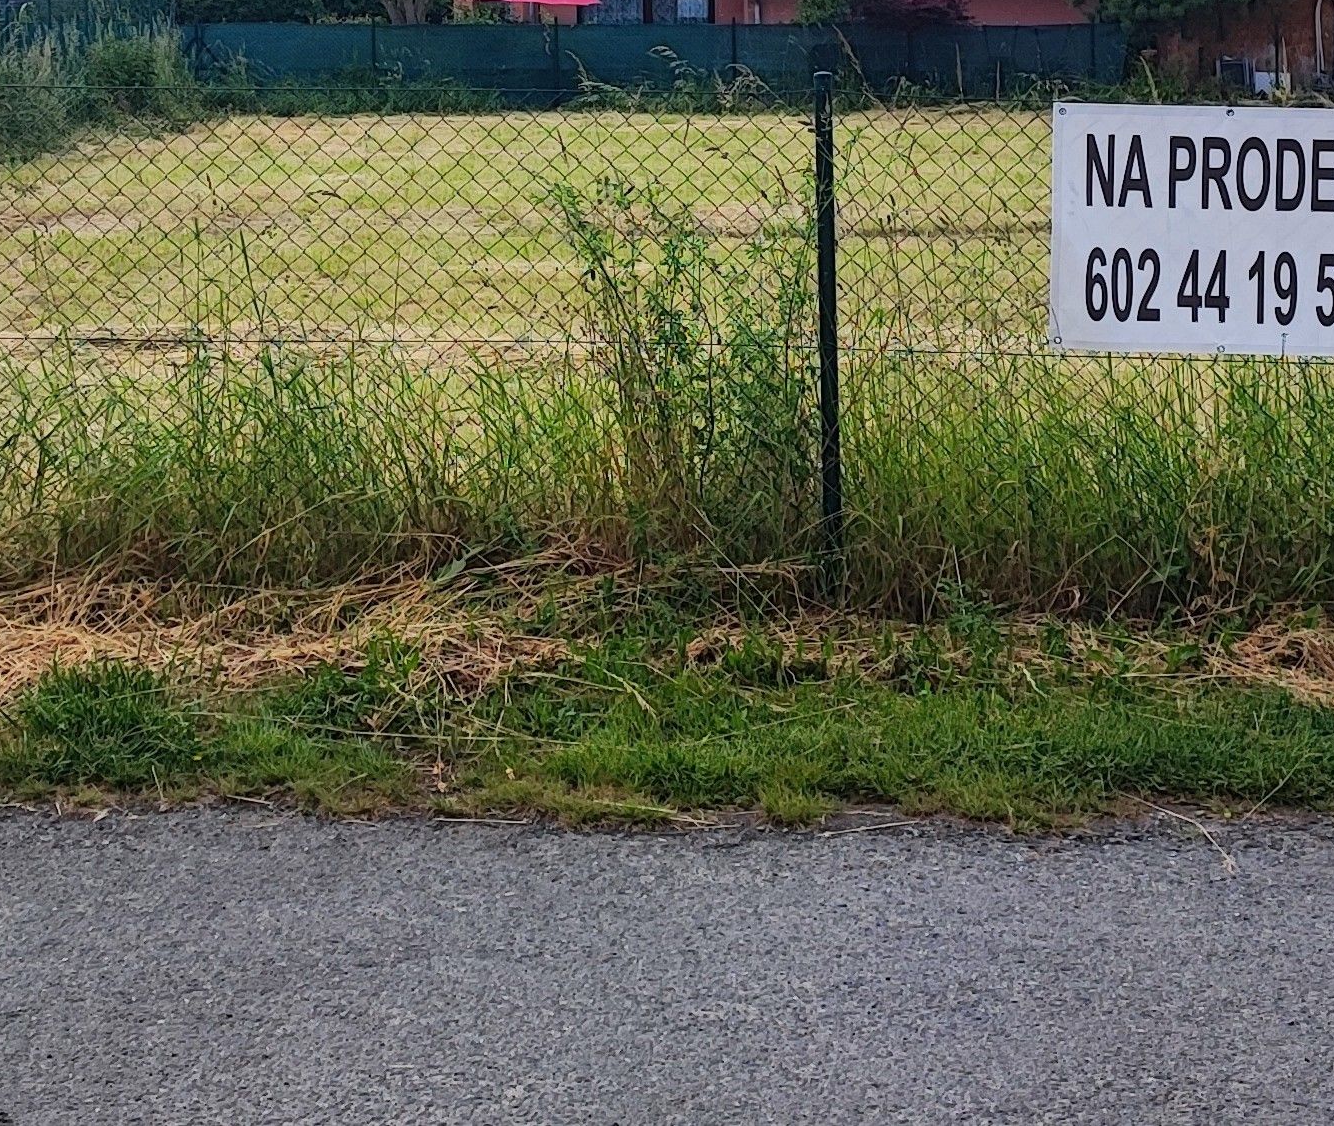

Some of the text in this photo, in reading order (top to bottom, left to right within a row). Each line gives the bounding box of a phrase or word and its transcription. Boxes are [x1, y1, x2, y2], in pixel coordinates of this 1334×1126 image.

[1086, 134, 1153, 208] NA
[1085, 246, 1161, 323] 602
[1176, 249, 1231, 324] 44
[1248, 250, 1298, 327] 19
